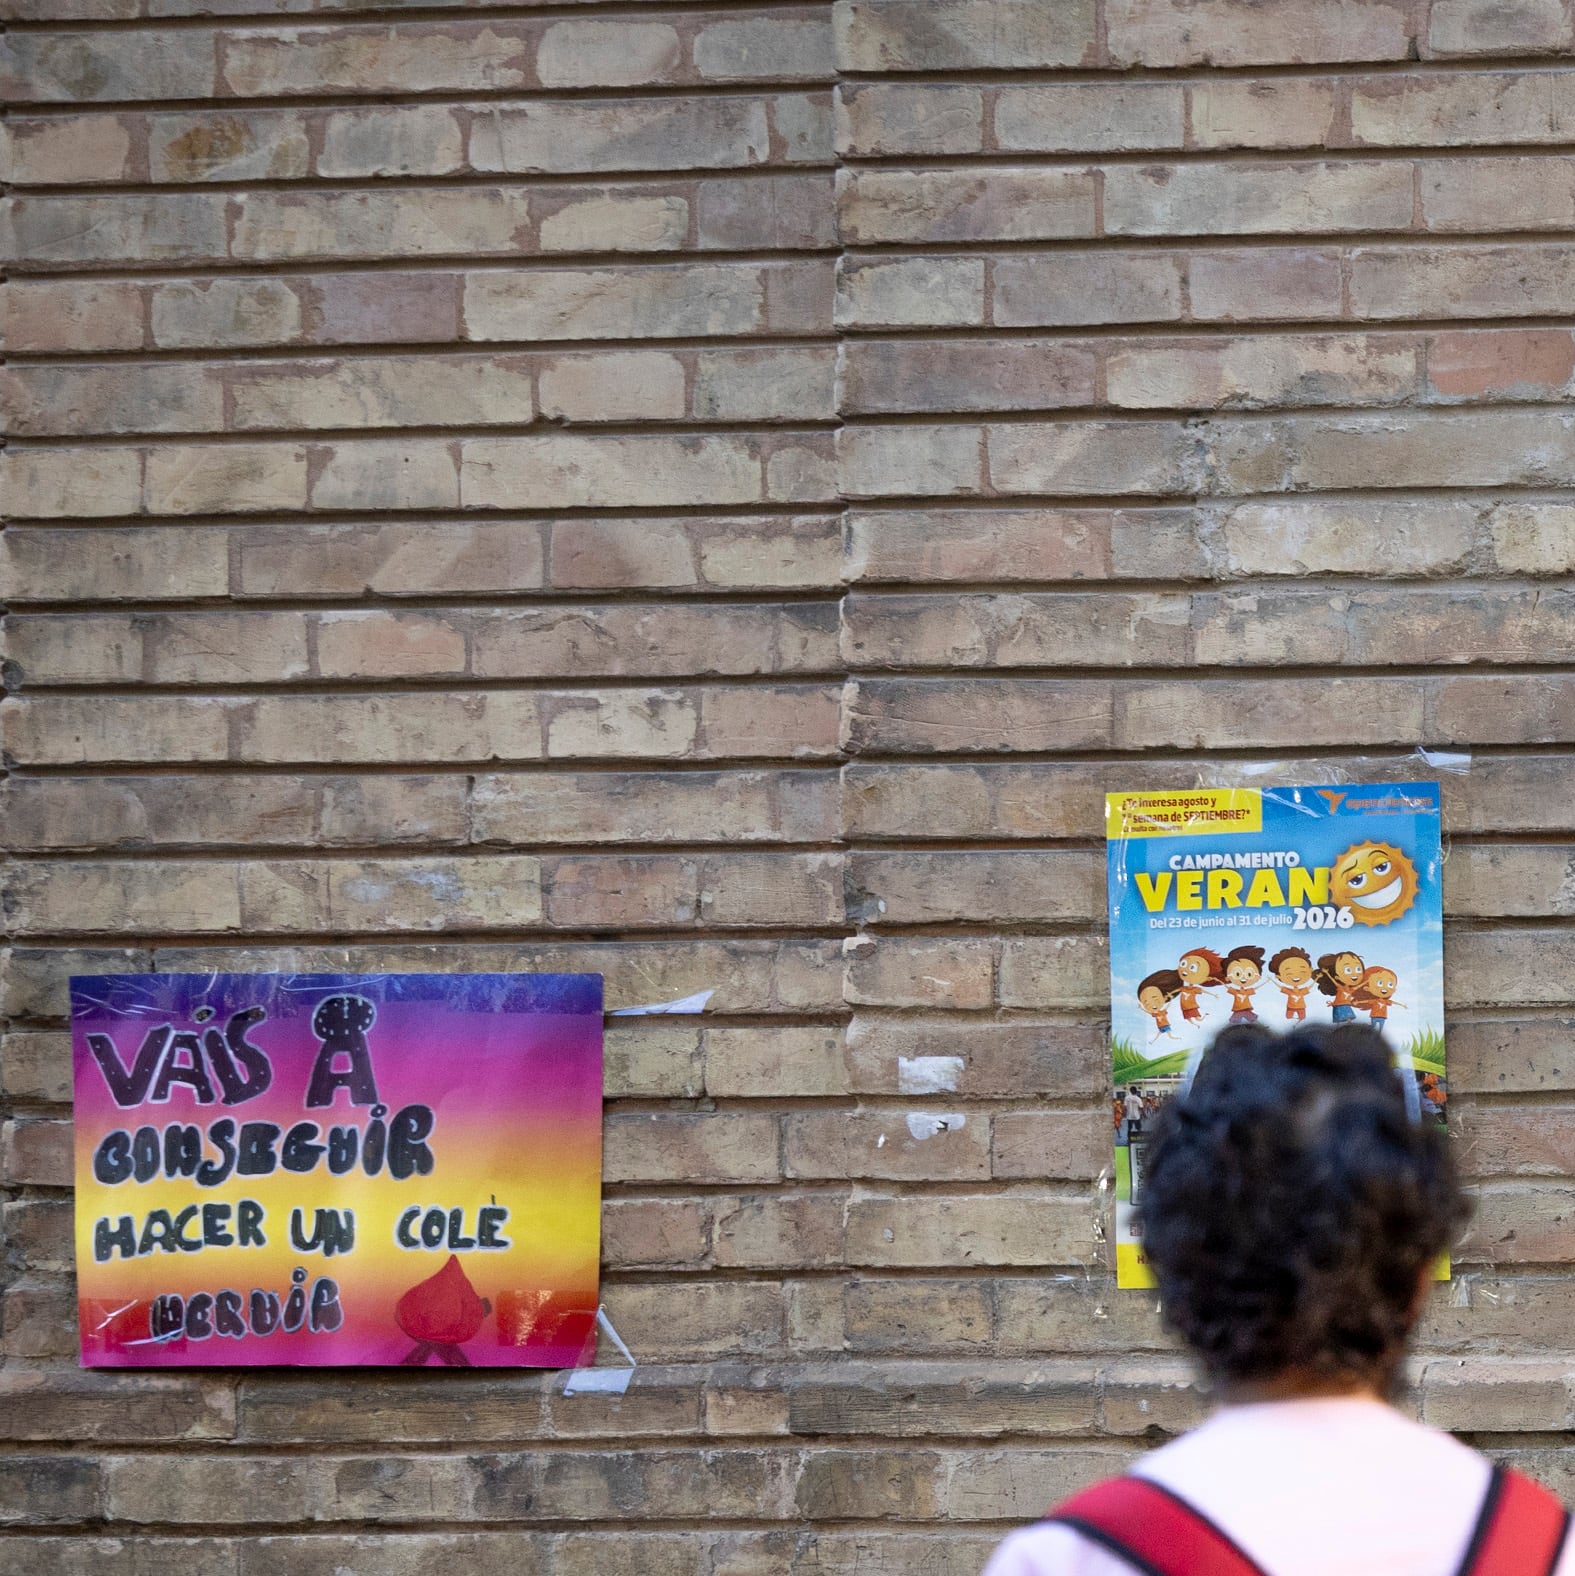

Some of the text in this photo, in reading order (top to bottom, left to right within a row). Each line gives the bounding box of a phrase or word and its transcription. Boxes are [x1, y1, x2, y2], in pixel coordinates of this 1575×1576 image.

[1138, 797, 1177, 808] interesa
[1178, 797, 1209, 809] agosto
[1210, 797, 1217, 808] y
[1170, 811, 1182, 822] de
[1168, 851, 1300, 870] CAMPAMENTO
[1150, 911, 1293, 930] Del 23 de junio al 31 de julio
[1292, 906, 1355, 930] 2026
[93, 1199, 267, 1263] HACER
[290, 1206, 356, 1254] UN
